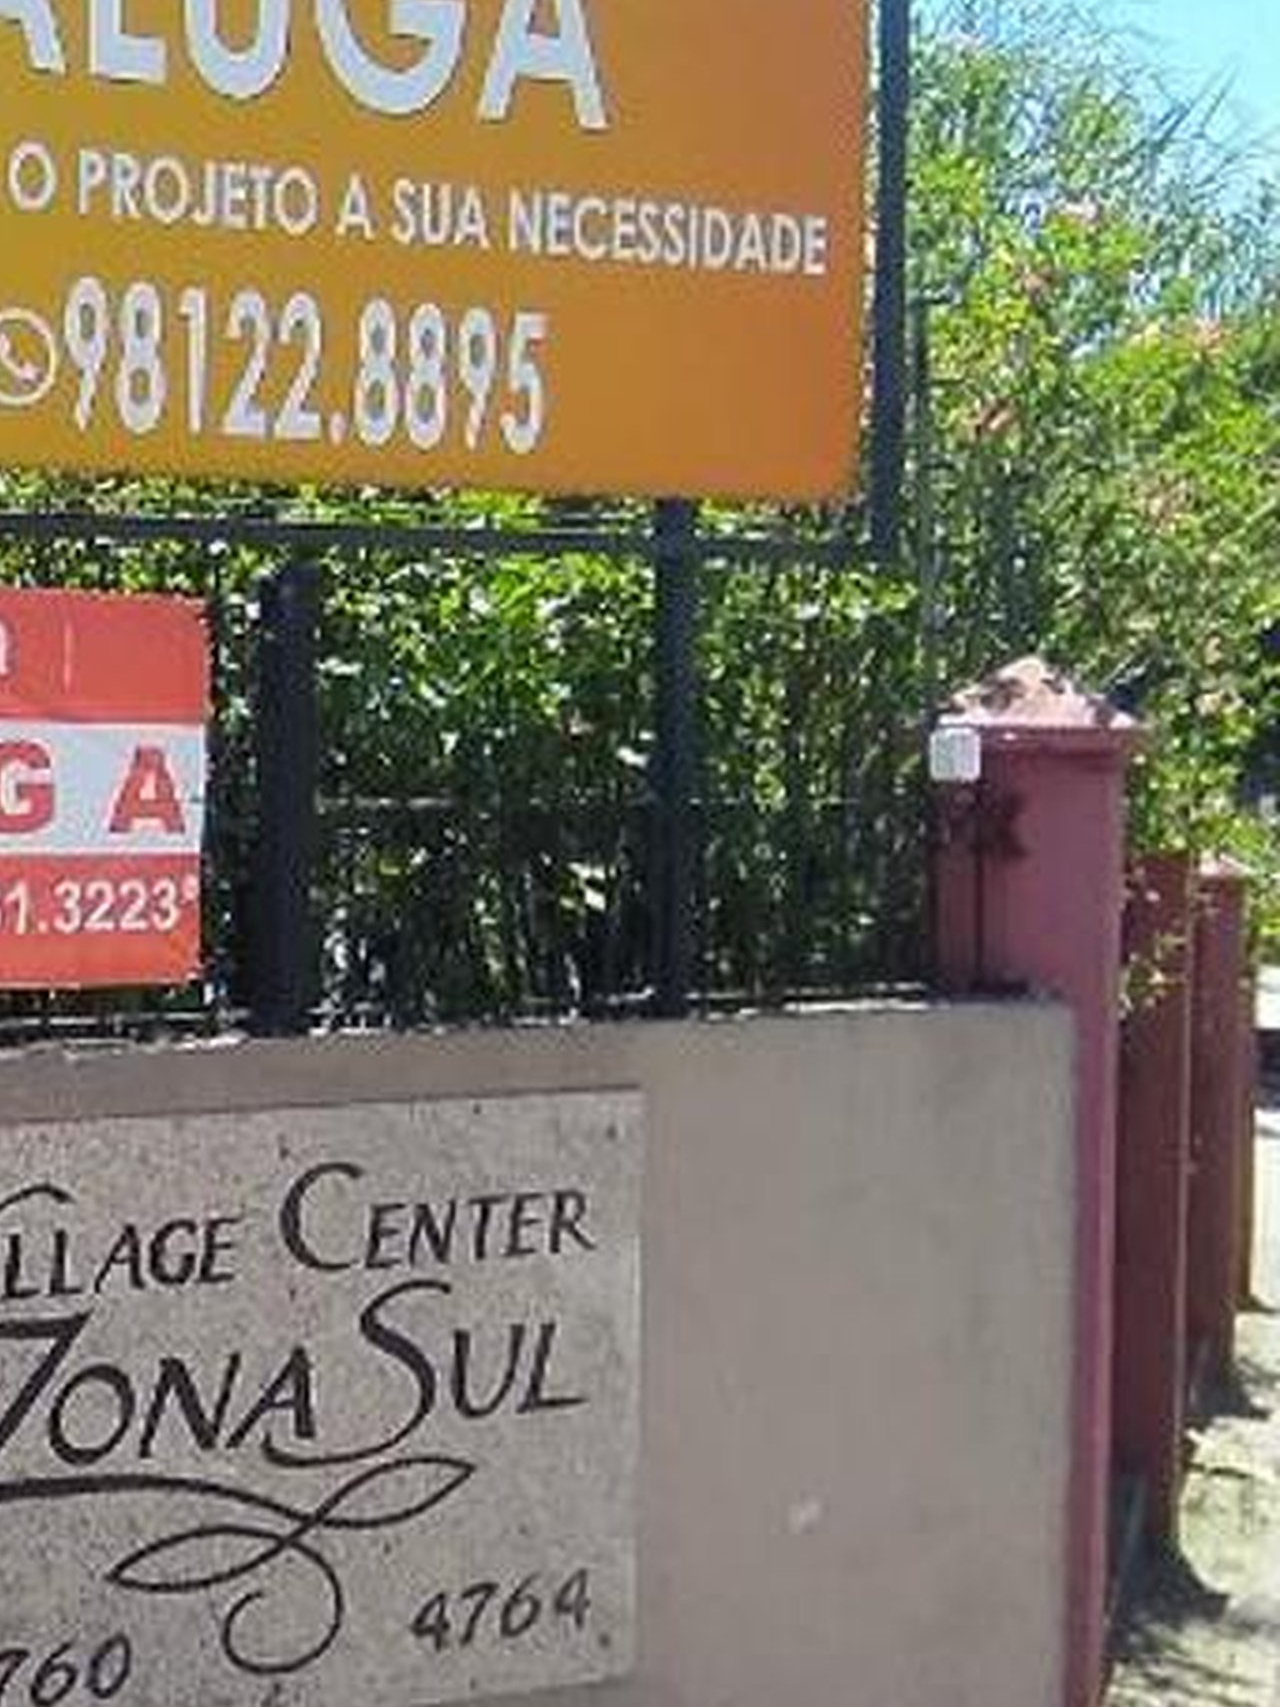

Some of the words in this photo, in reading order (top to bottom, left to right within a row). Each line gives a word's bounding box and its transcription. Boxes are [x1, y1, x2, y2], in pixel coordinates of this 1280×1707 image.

[8, 140, 56, 211] O
[78, 149, 319, 236] PROJETO
[336, 171, 374, 242] A
[392, 177, 490, 249] SUA
[508, 186, 829, 276] NECESSIDADE
[64, 275, 551, 456] 98122.8895
[280, 1161, 596, 1270] CENTER
[262, 1279, 590, 1467] SUL
[410, 1567, 593, 1653] 4764
